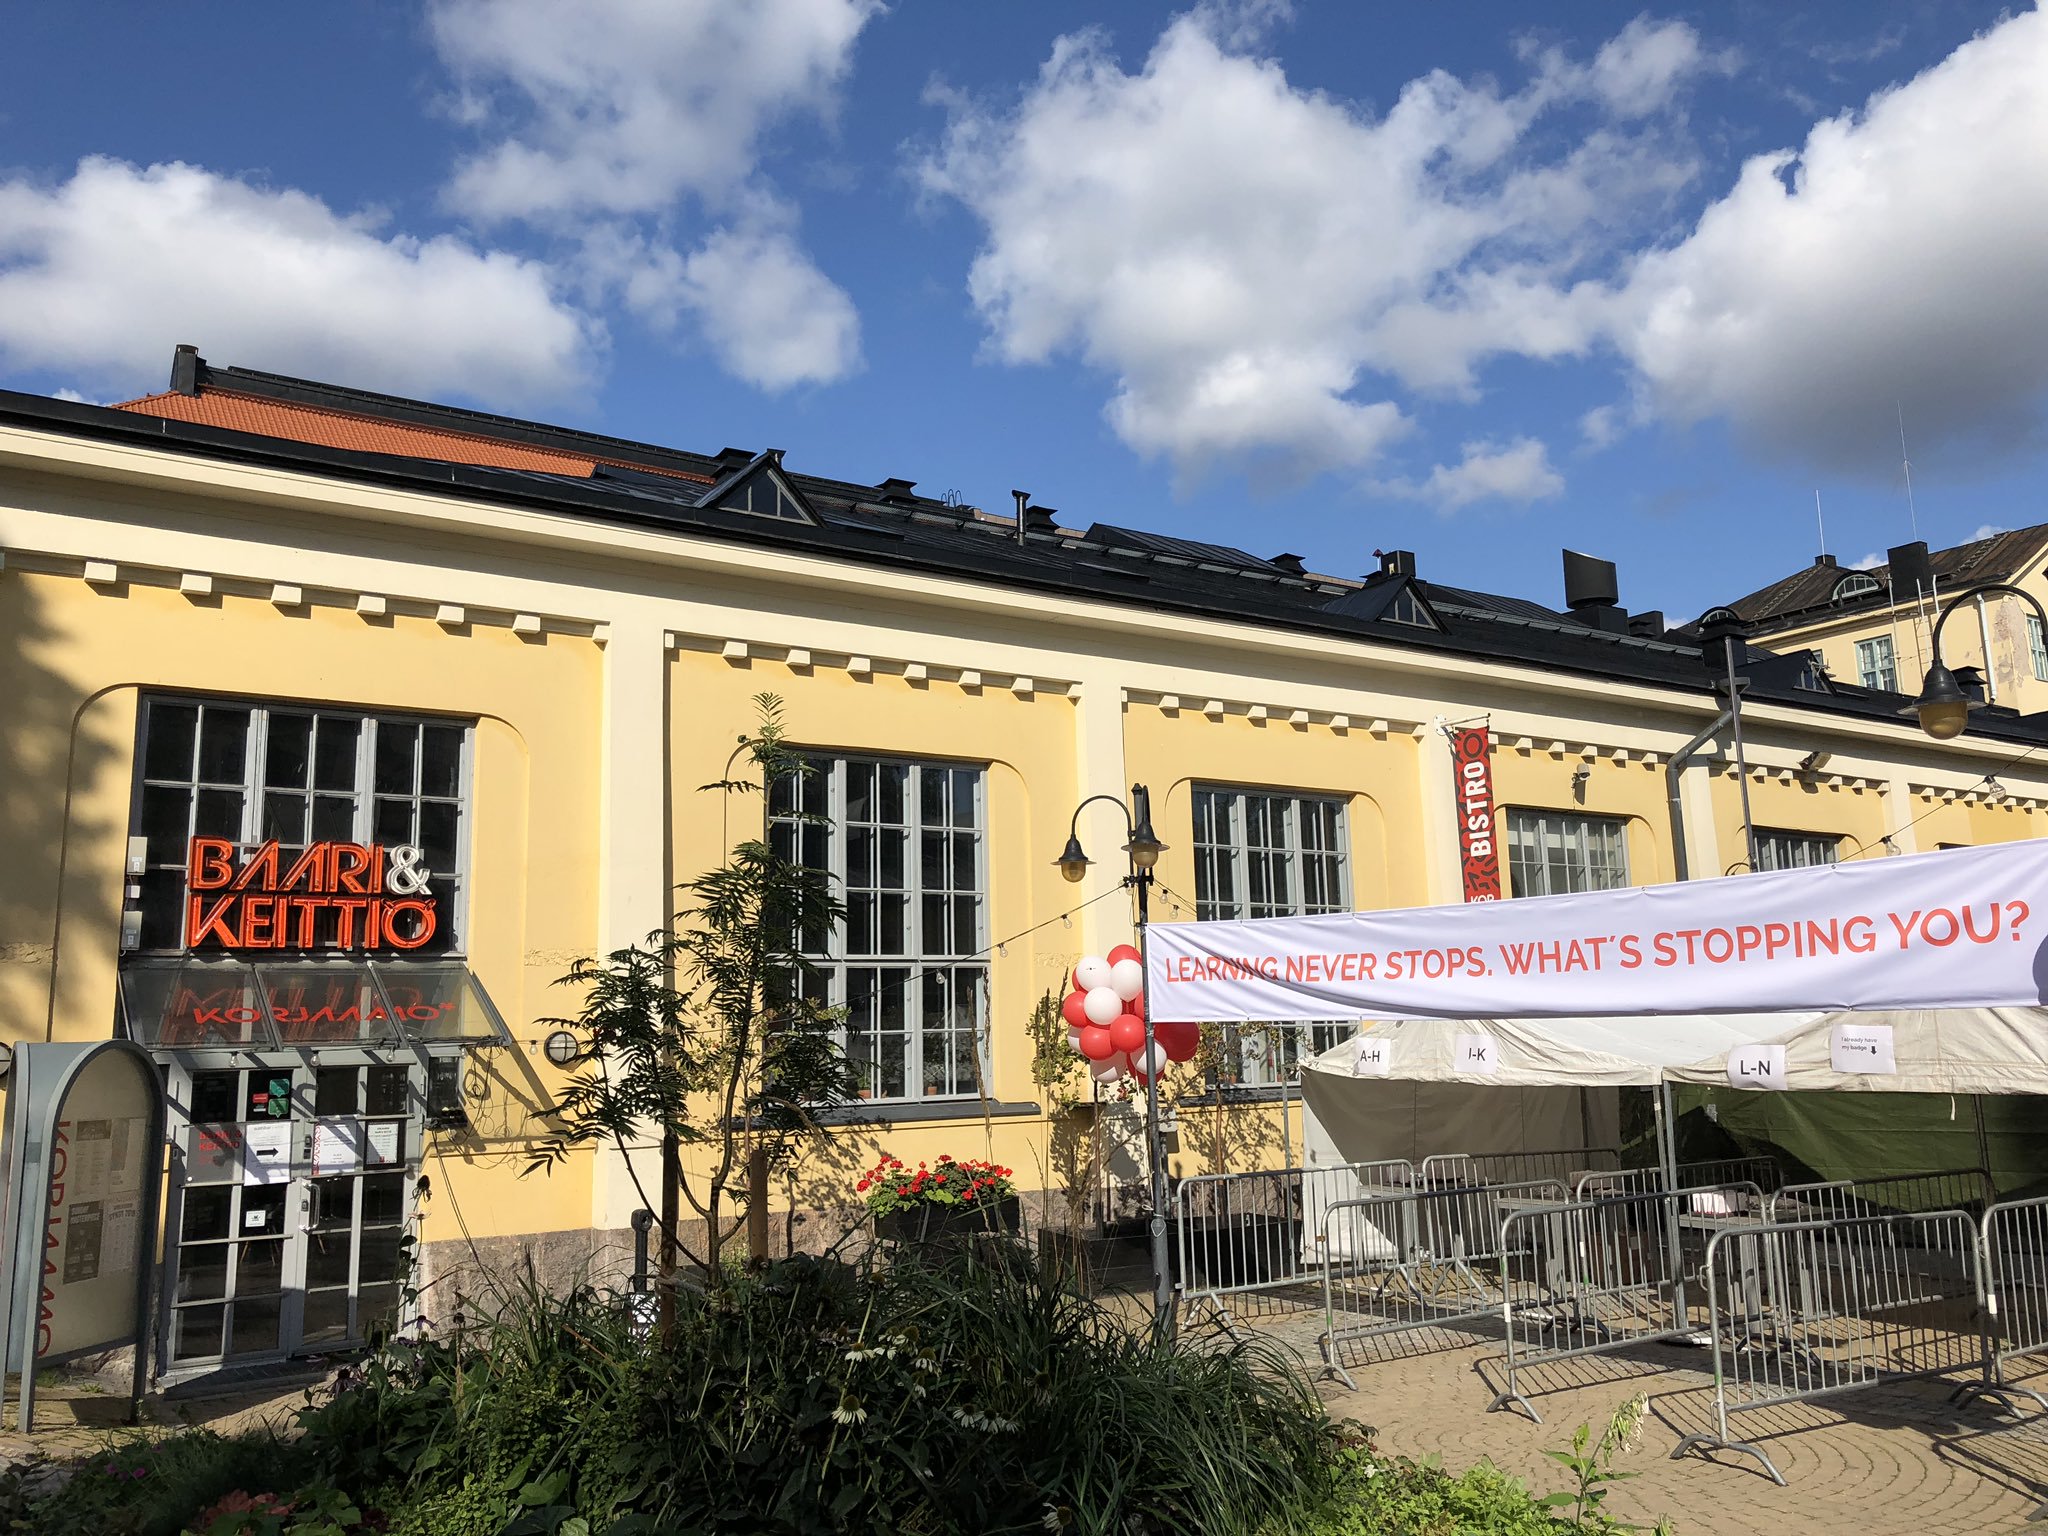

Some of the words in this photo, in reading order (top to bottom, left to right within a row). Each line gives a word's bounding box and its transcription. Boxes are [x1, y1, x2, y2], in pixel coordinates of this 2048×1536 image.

[1463, 761, 1492, 858] BISTRO
[186, 894, 437, 949] KEITTIÖ
[1166, 955, 1280, 984] LEARNING
[1285, 952, 1377, 983] NEVER
[1384, 945, 1493, 980] STOPS.
[1498, 934, 1643, 976] WHAT'S
[1653, 915, 1877, 967] STOPPING
[1887, 899, 2030, 950] YOU?
[1360, 1049, 1381, 1063] A-H
[1468, 1047, 1487, 1062] I-K
[1740, 1060, 1771, 1076] L-N
